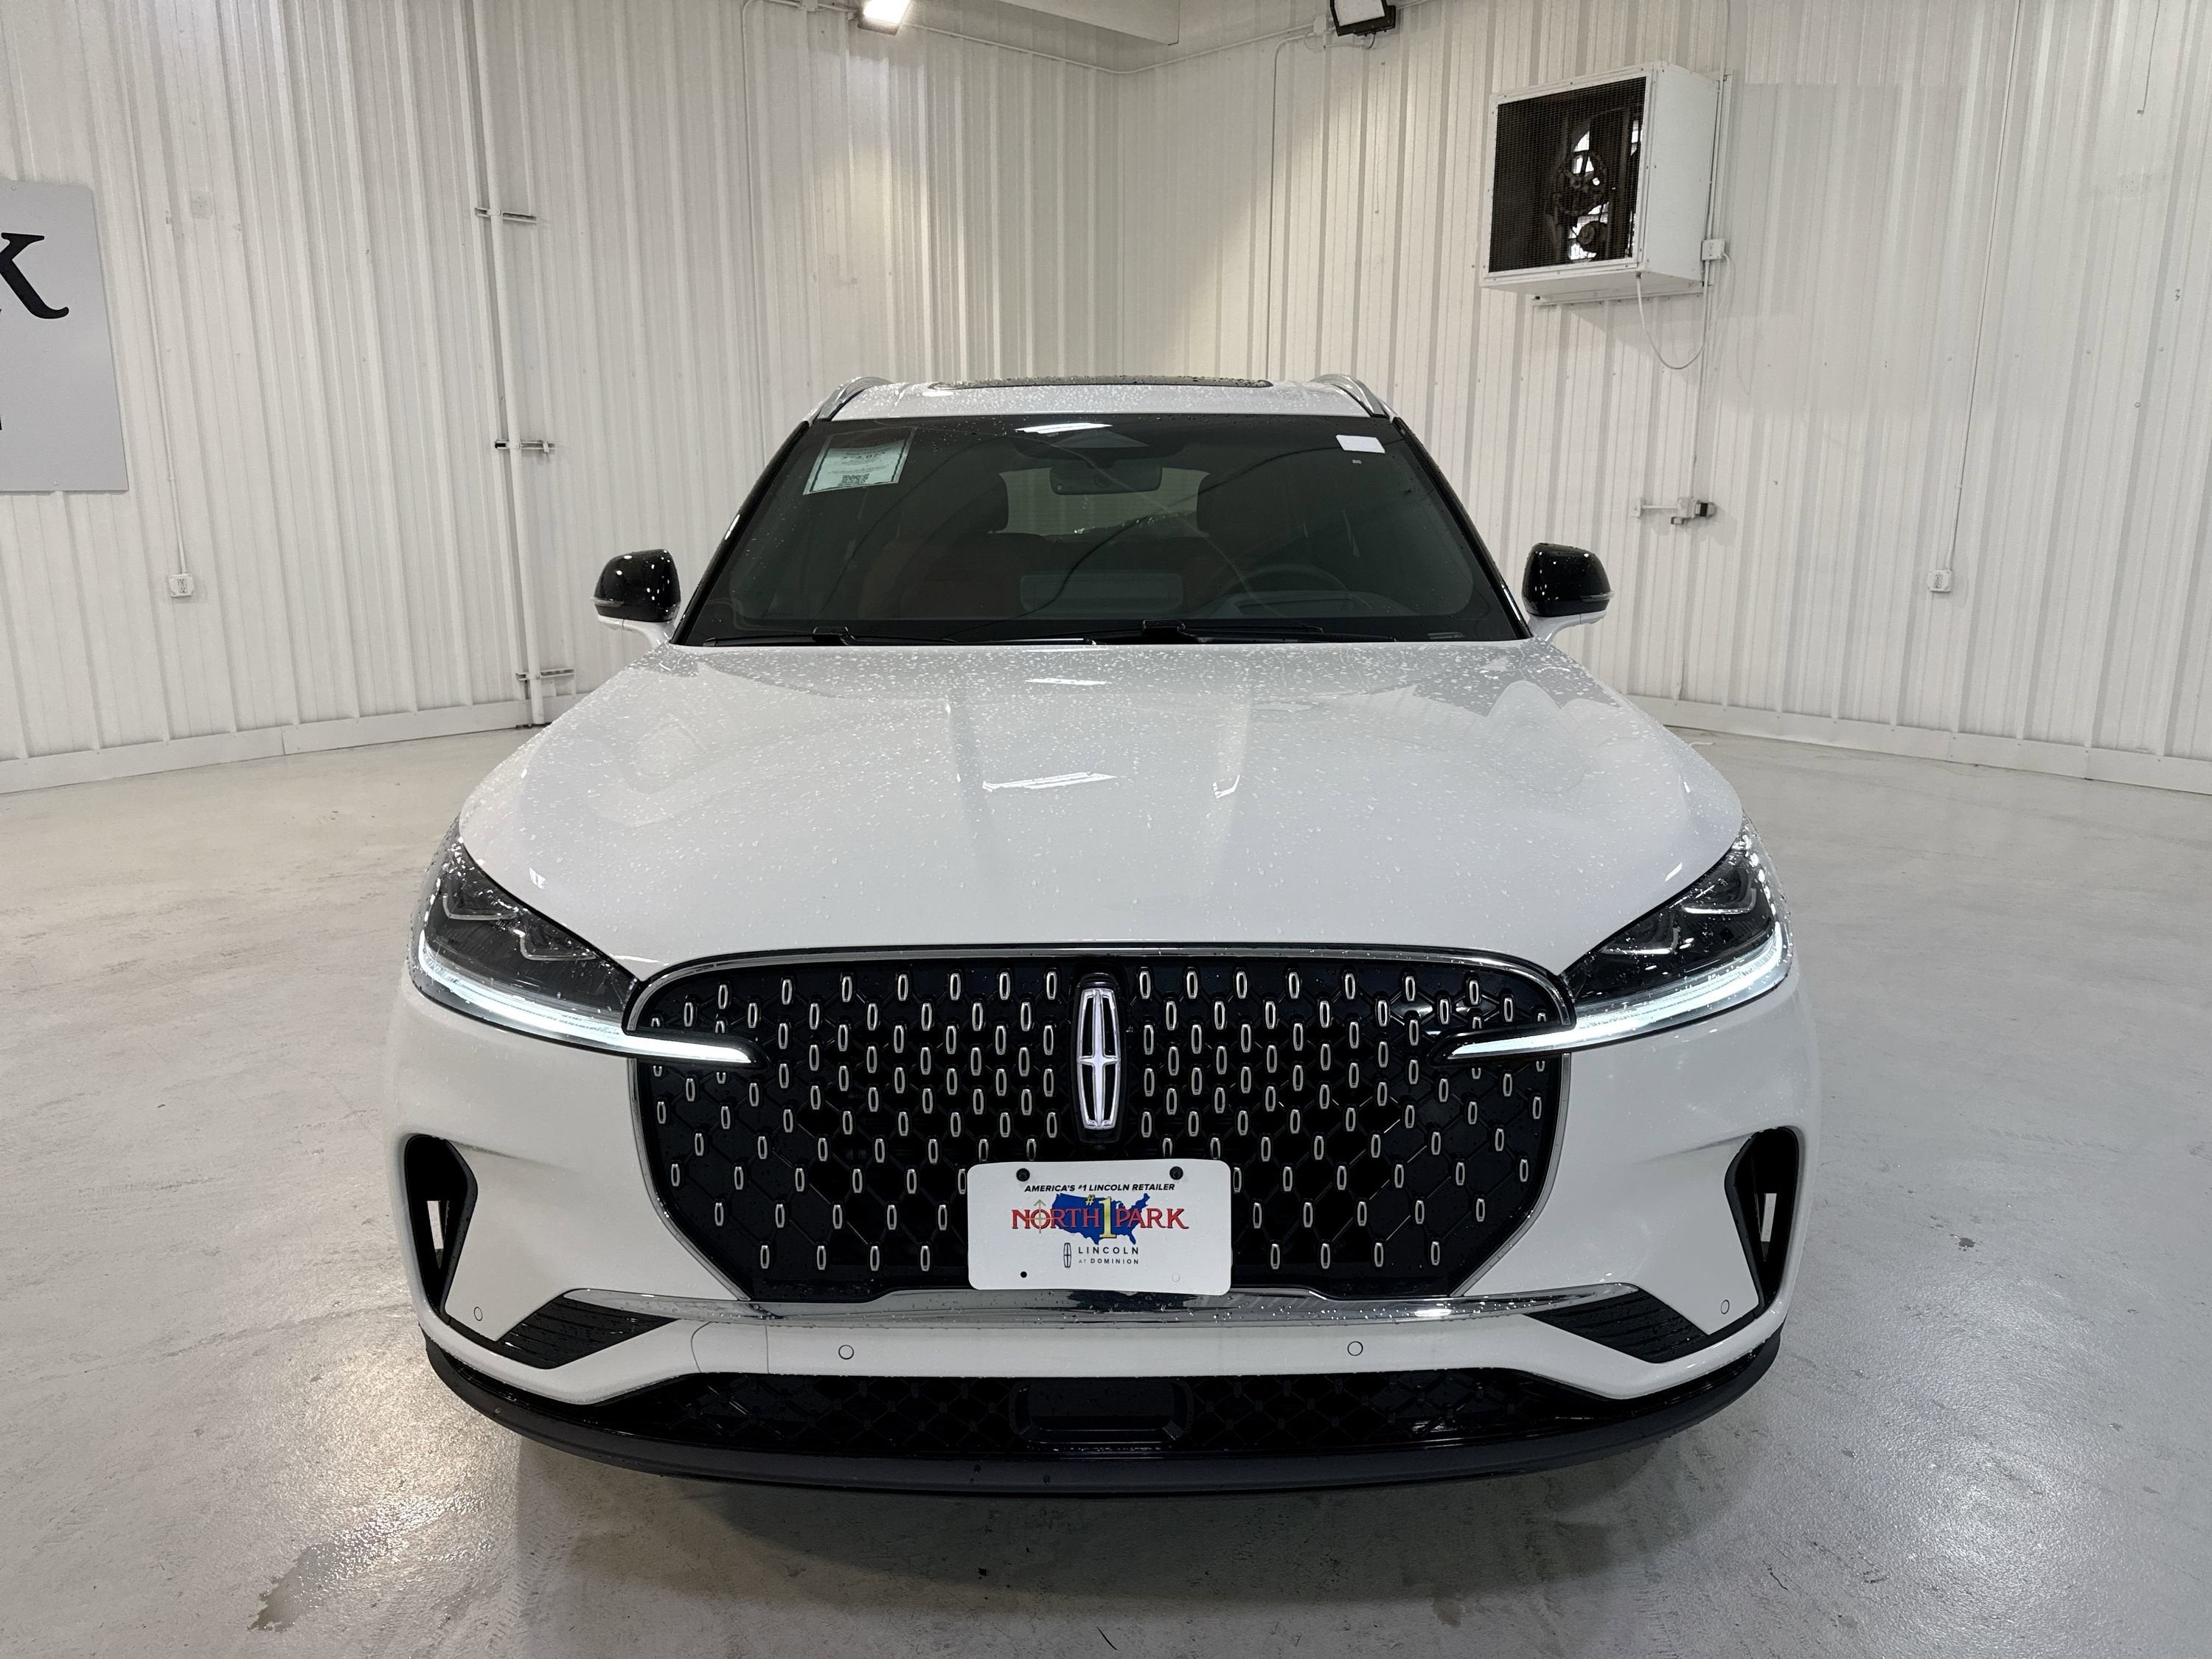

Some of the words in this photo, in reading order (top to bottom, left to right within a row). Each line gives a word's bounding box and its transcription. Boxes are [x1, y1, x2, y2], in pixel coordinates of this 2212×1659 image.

[1024, 1184, 1076, 1192] AMERICA'S
[1089, 1183, 1131, 1192] LINCOLN
[1012, 1208, 1100, 1230] NORTH
[1115, 1208, 1189, 1230] PARK
[1078, 1246, 1138, 1255] LINCOLN
